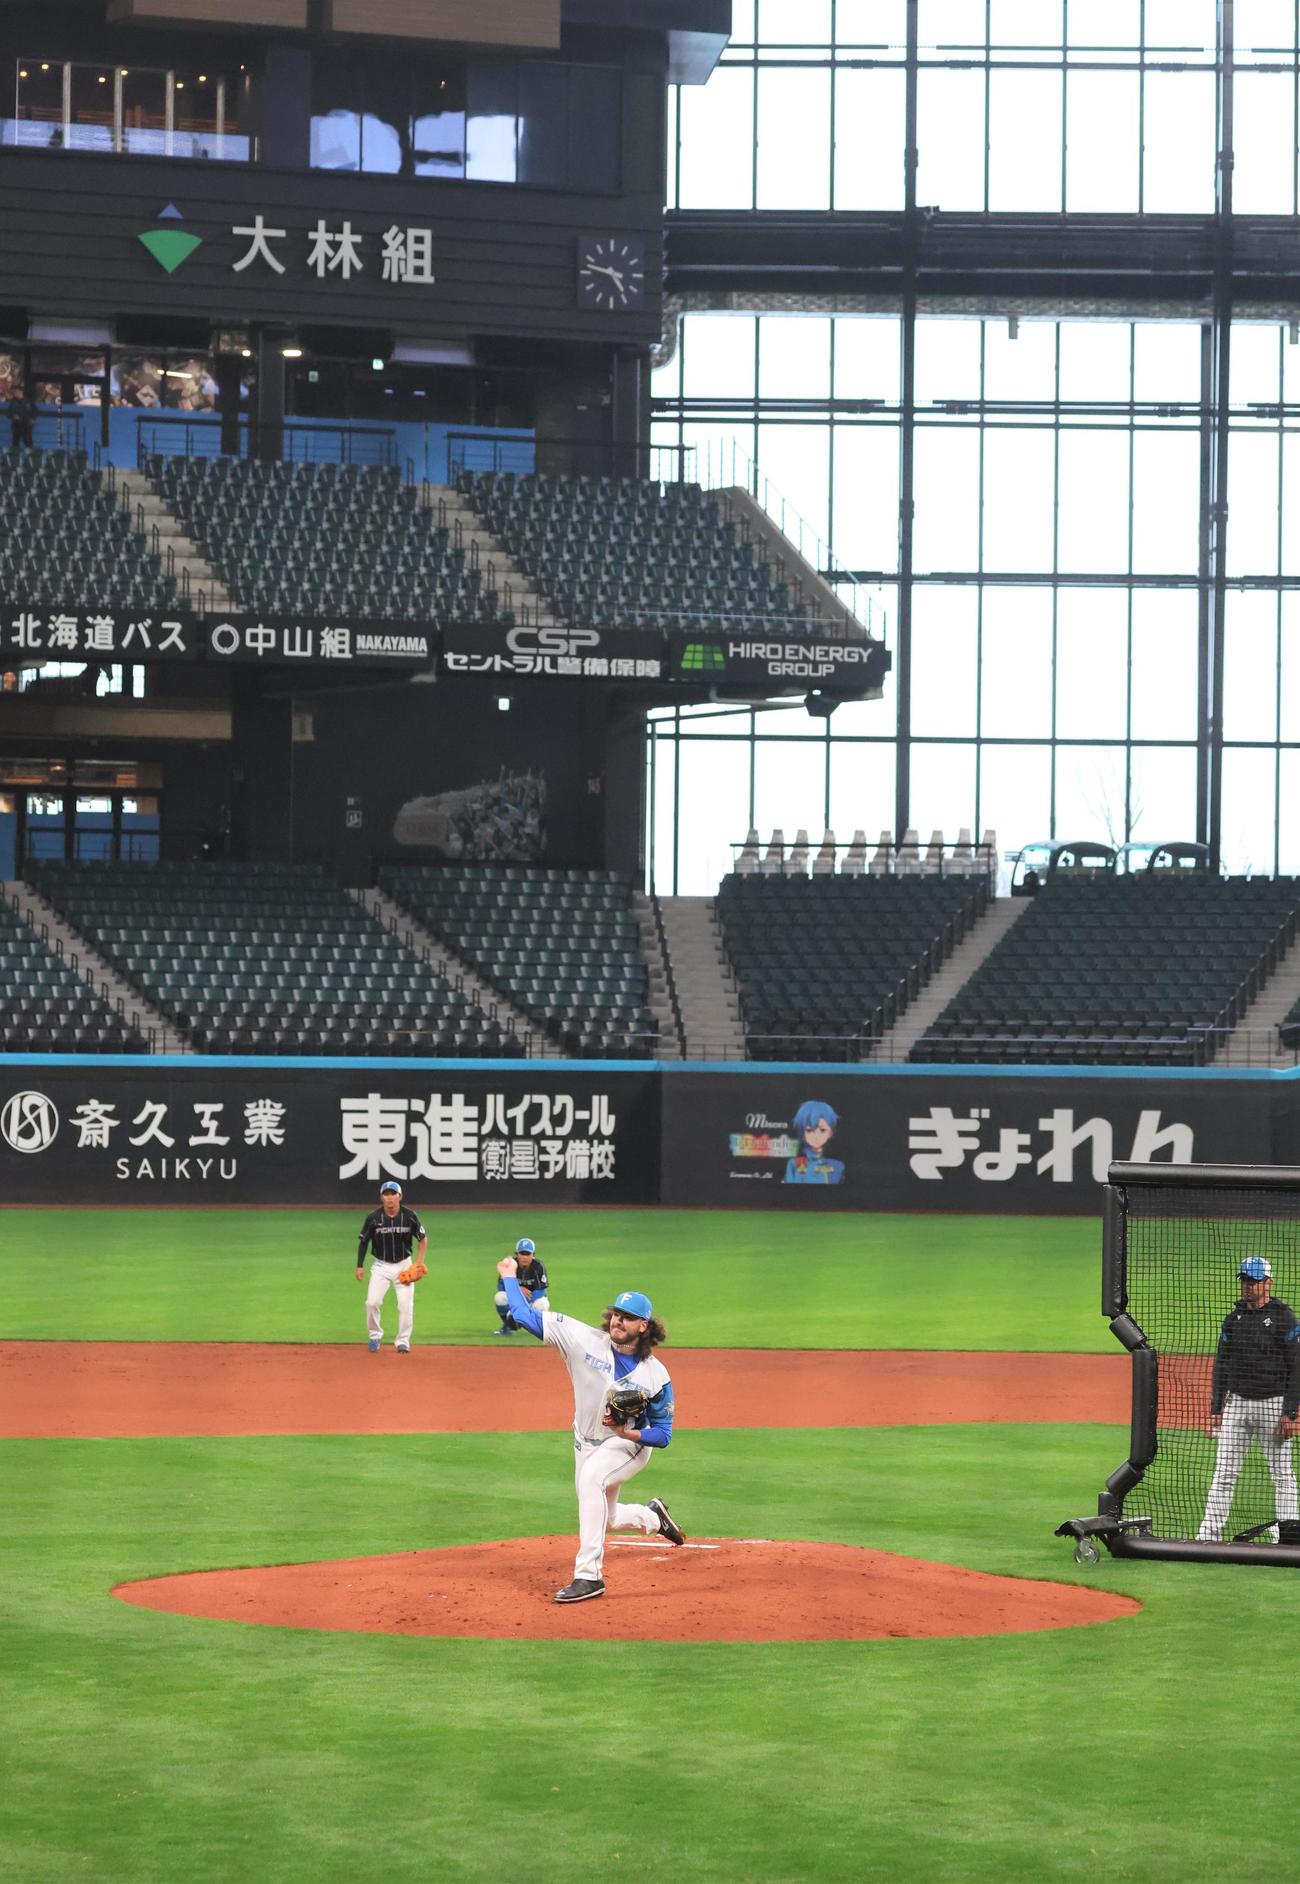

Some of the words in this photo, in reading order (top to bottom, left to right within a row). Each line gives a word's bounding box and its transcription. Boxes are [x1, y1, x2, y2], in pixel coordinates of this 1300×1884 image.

[232, 215, 434, 284] 大林組
[10, 612, 185, 652] 北海道バス
[245, 624, 352, 659] 中山組
[356, 634, 427, 651] NAKAYAMA
[507, 626, 600, 651] CSP
[443, 651, 661, 678] セントラル警備保障
[767, 661, 835, 678] GROUP
[481, 1094, 615, 1136] ハイスクール
[339, 1092, 479, 1181] 東進
[908, 1108, 1195, 1183] ぎょれん
[116, 1157, 237, 1180] SAIKYU
[481, 1139, 615, 1180] 衛星予備校
[621, 1293, 633, 1306] F
